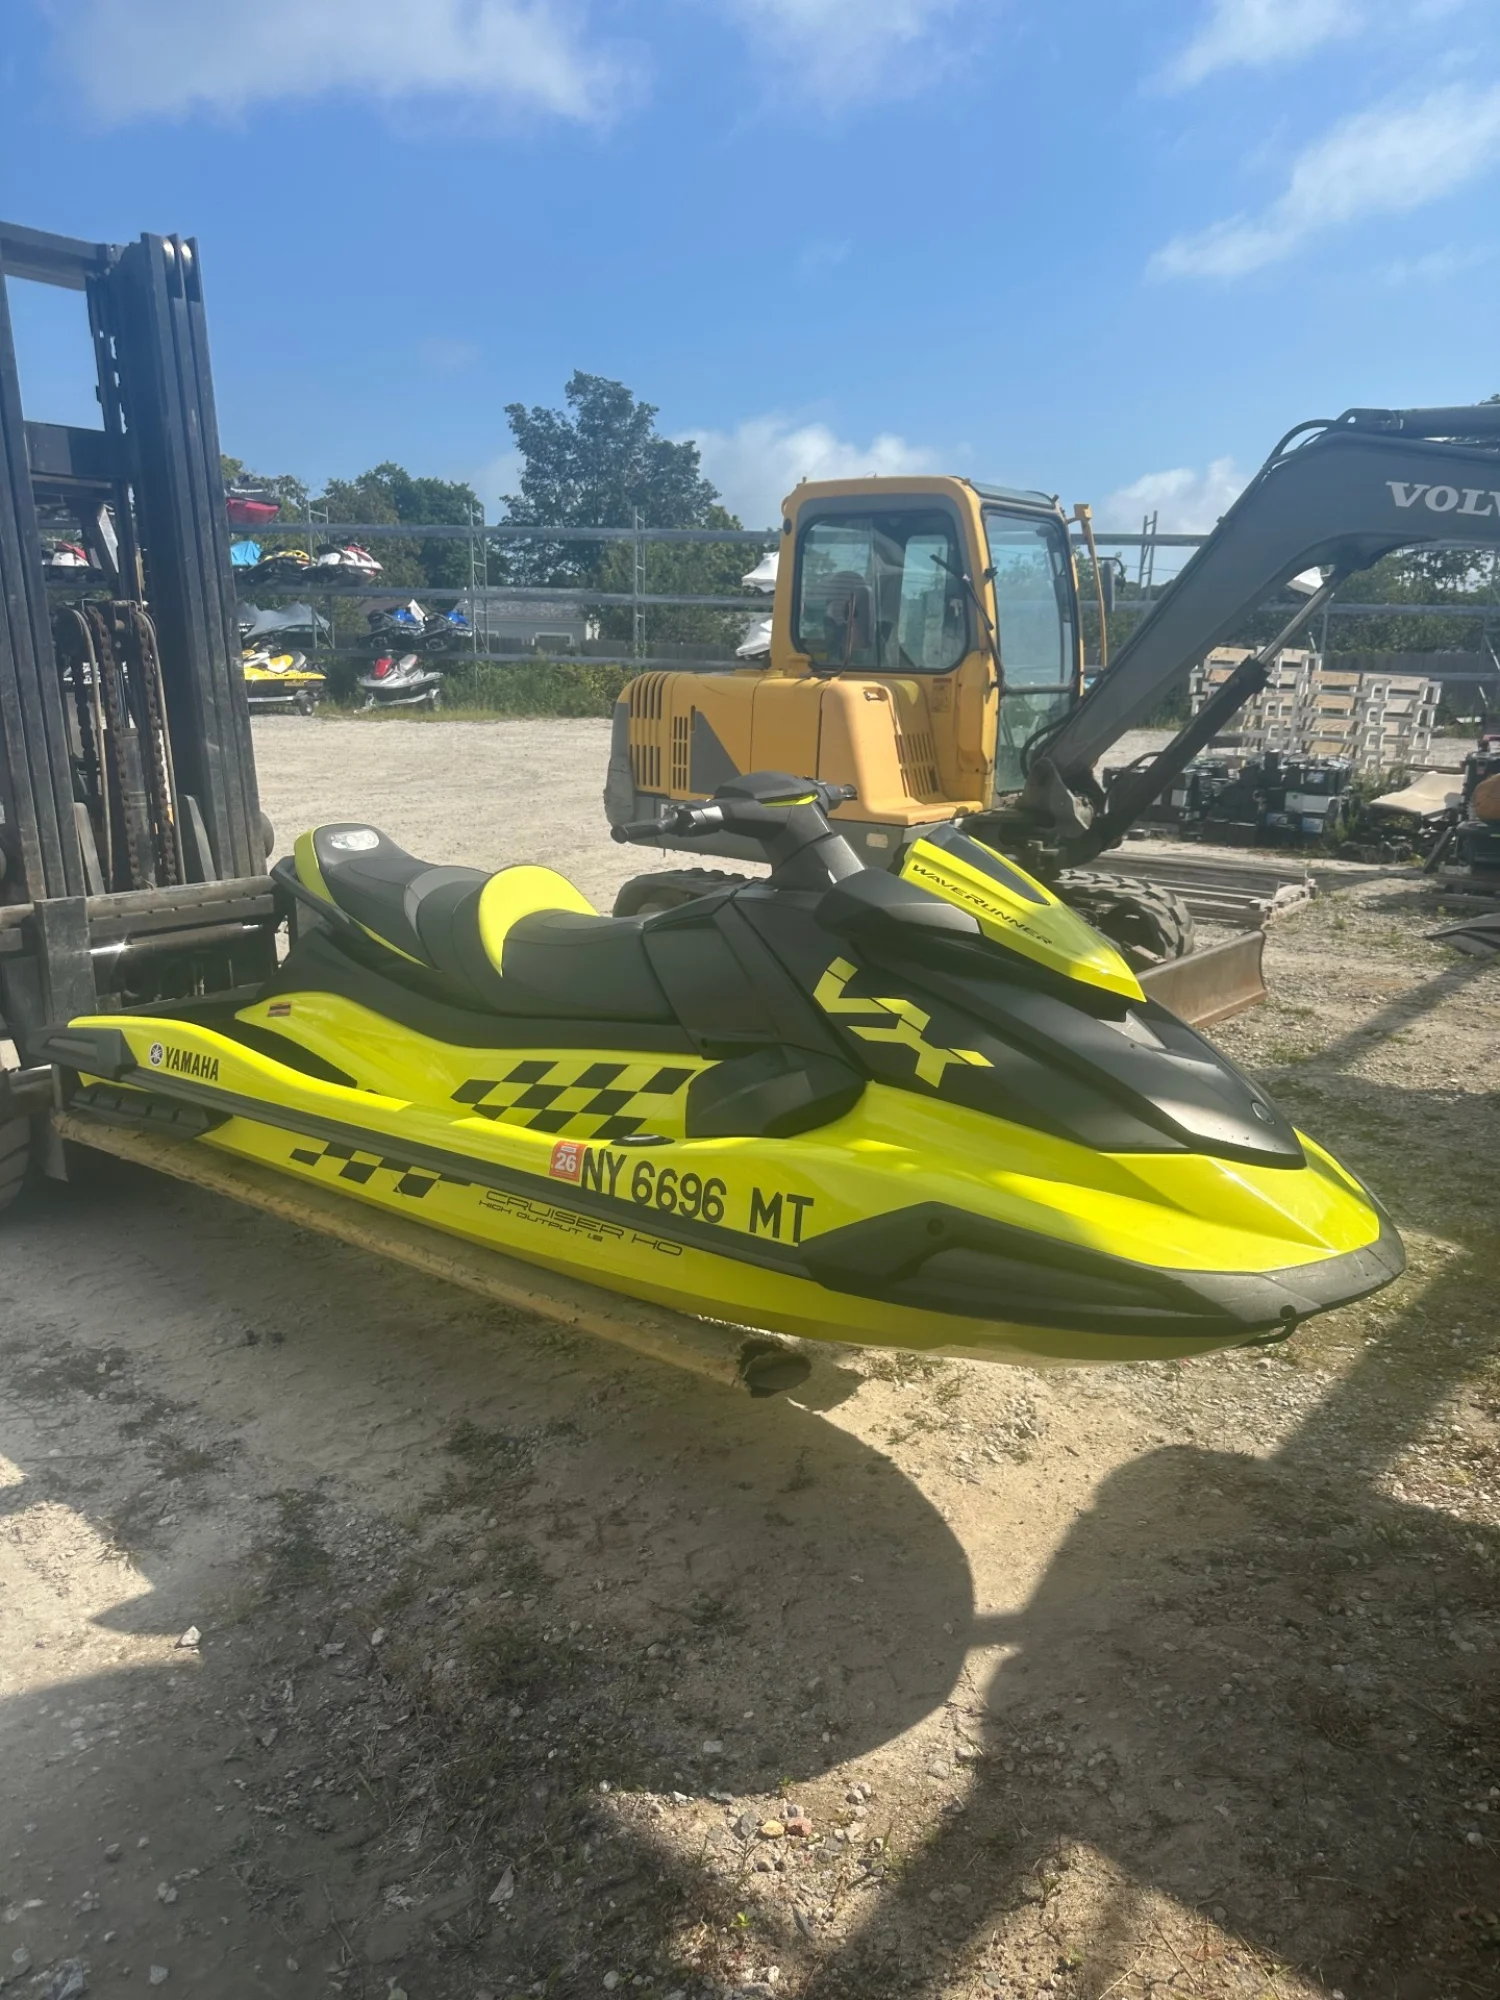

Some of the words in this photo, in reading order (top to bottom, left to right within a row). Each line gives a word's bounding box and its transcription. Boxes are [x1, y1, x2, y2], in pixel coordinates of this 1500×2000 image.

[1385, 481, 1500, 517] VOL
[912, 864, 1052, 945] WAVERUNNER
[813, 956, 995, 1088] VX
[166, 1046, 219, 1081] YAMAHA
[555, 1152, 576, 1173] 26
[479, 1200, 512, 1215] HIGH
[516, 1211, 583, 1235] OUTPUT
[581, 1147, 627, 1197] NY
[631, 1160, 727, 1224] 6696
[750, 1187, 815, 1244] MT
[486, 1190, 624, 1240] CRUISER
[631, 1233, 683, 1257] HO
